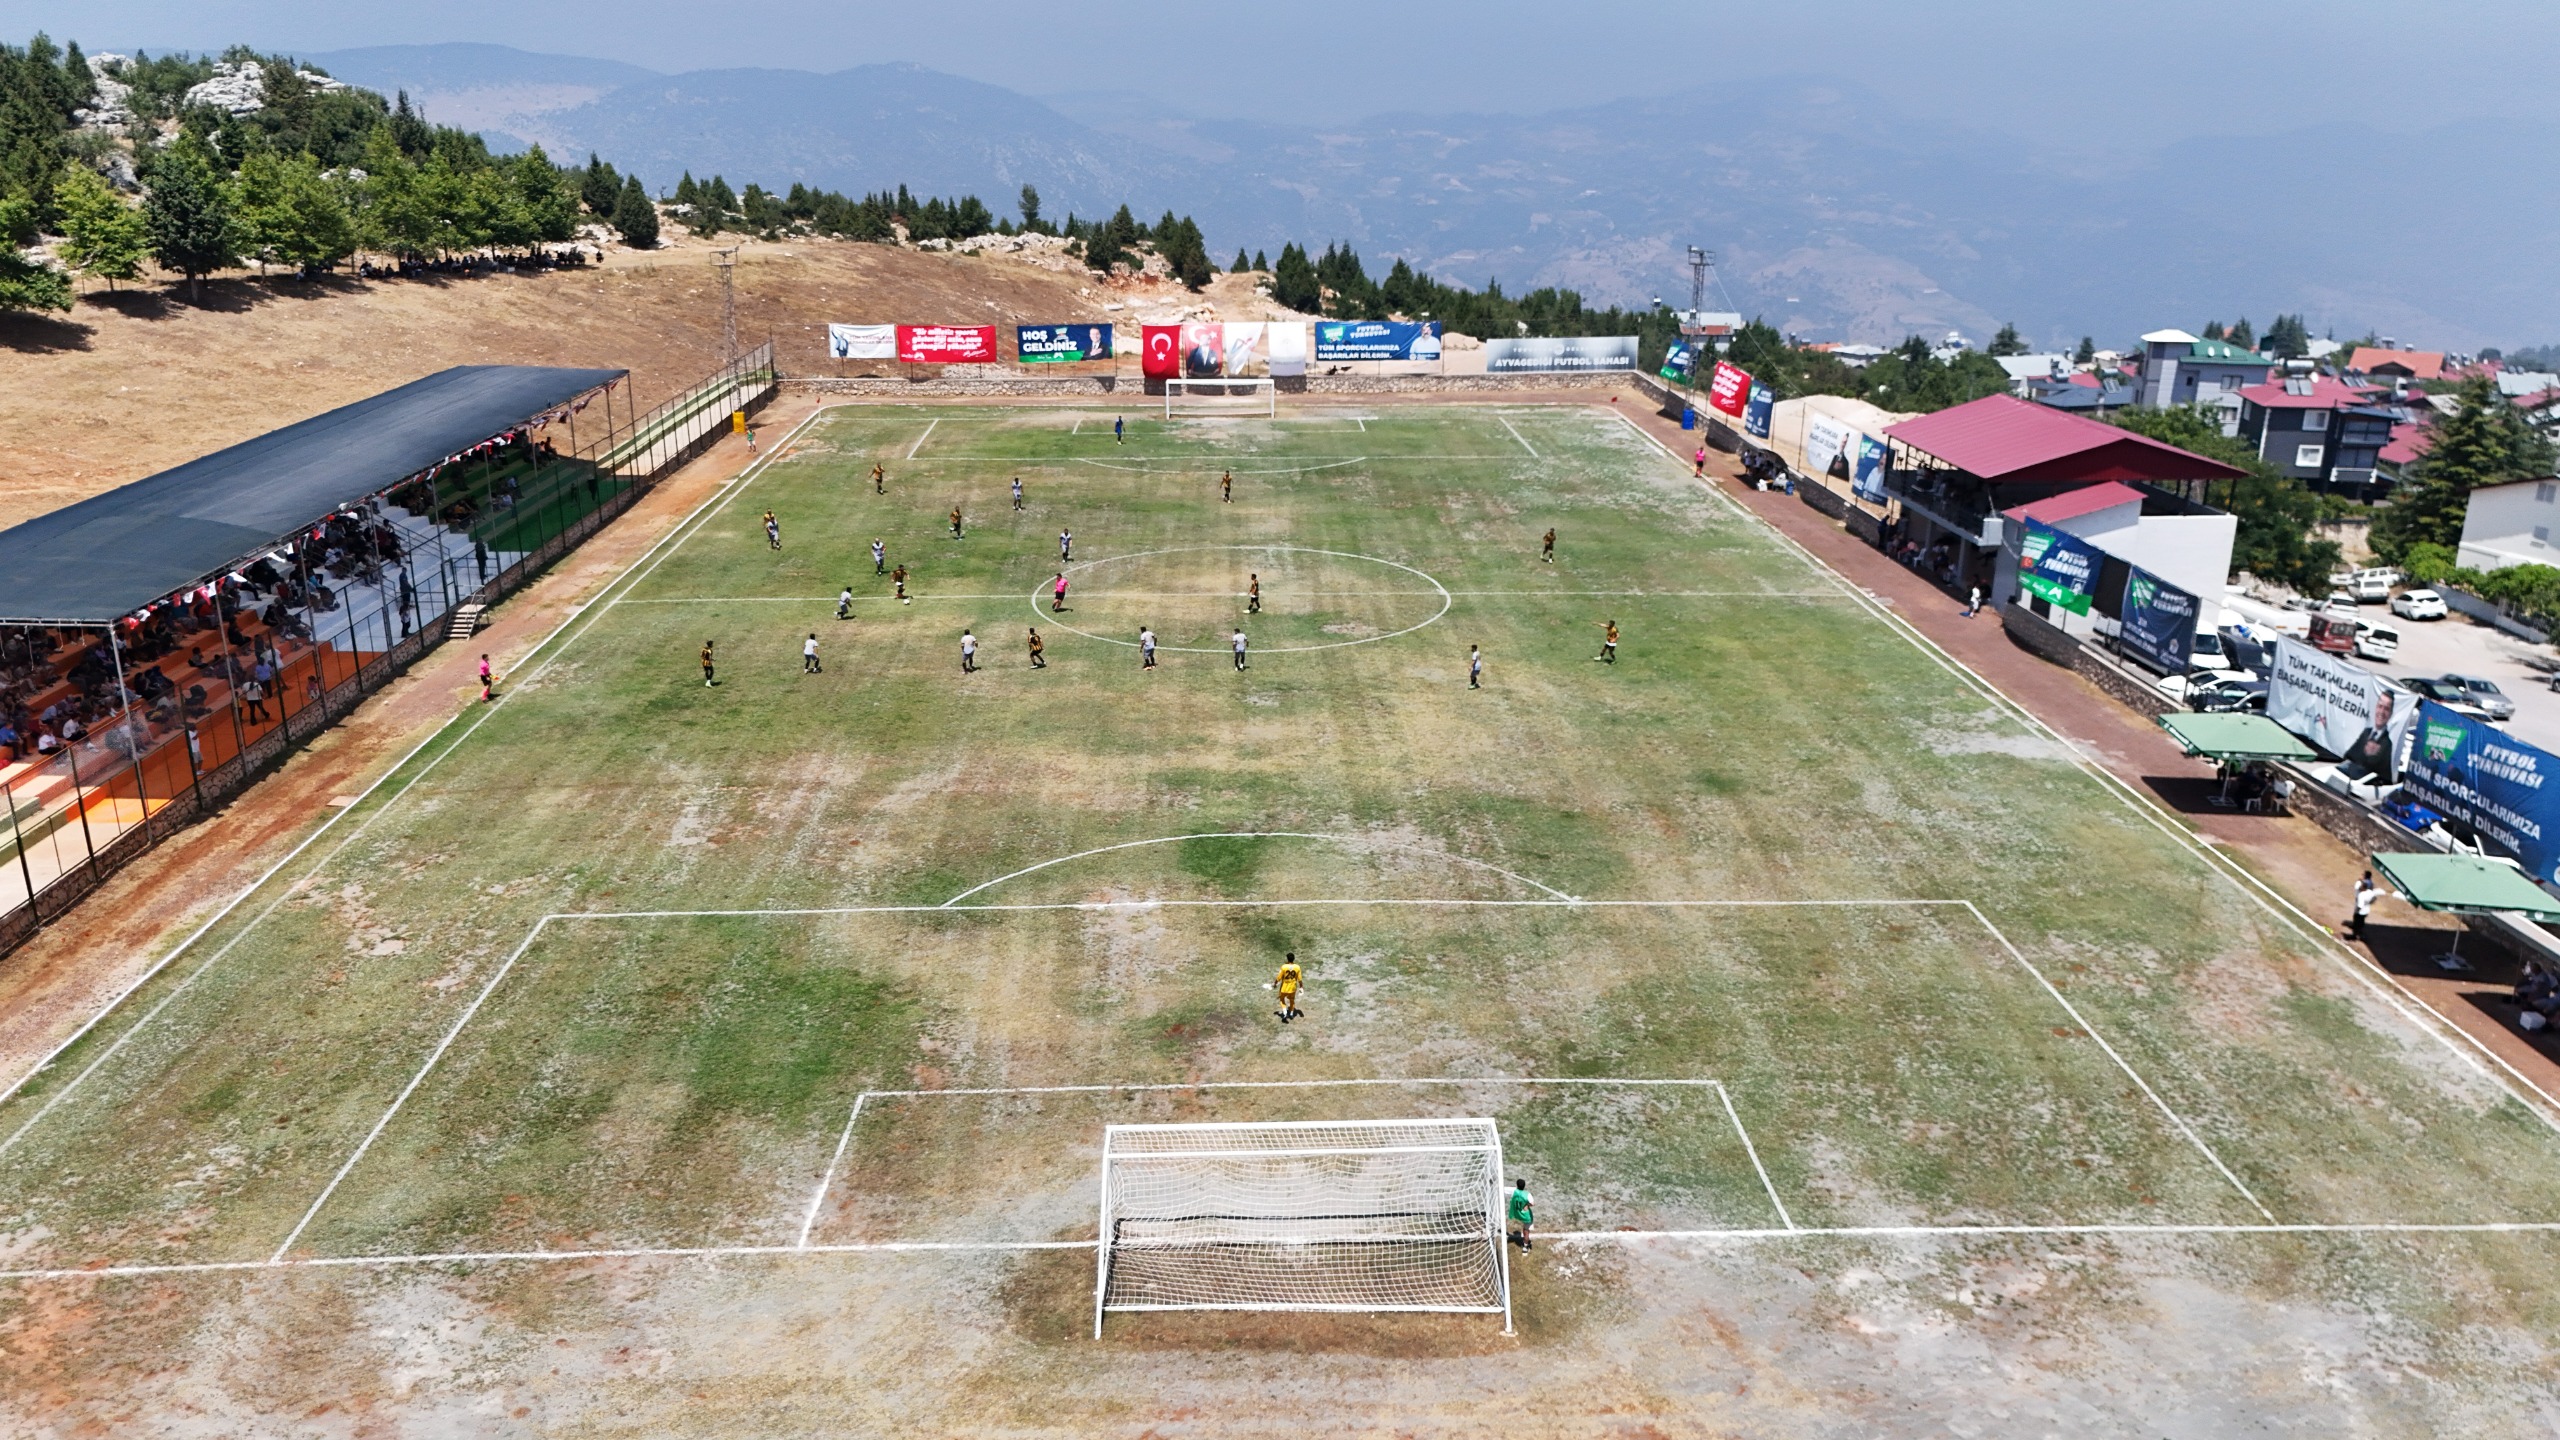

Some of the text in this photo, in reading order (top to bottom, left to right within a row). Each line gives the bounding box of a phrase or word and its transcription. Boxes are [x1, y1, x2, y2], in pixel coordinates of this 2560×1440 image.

[1022, 330, 1048, 342] HOŞ
[1022, 340, 1078, 352] GELDİNİZ
[1318, 352, 1359, 360] BAŞARILAR
[1554, 357, 1591, 366] FUTBOL
[1593, 356, 1629, 365] SAHASI
[2288, 654, 2365, 699] TÜM TAKIMLARA
[2277, 668, 2370, 720] BAŞARILAR DİLERİM
[2467, 753, 2545, 790] TURNUVASI
[2482, 743, 2537, 772] FUTBOL
[2408, 760, 2541, 841] TÜM SPORCULARIMIZA
[2404, 779, 2521, 855] BAŞARILAR DİLERİM.
[1285, 969, 1297, 980] 29
